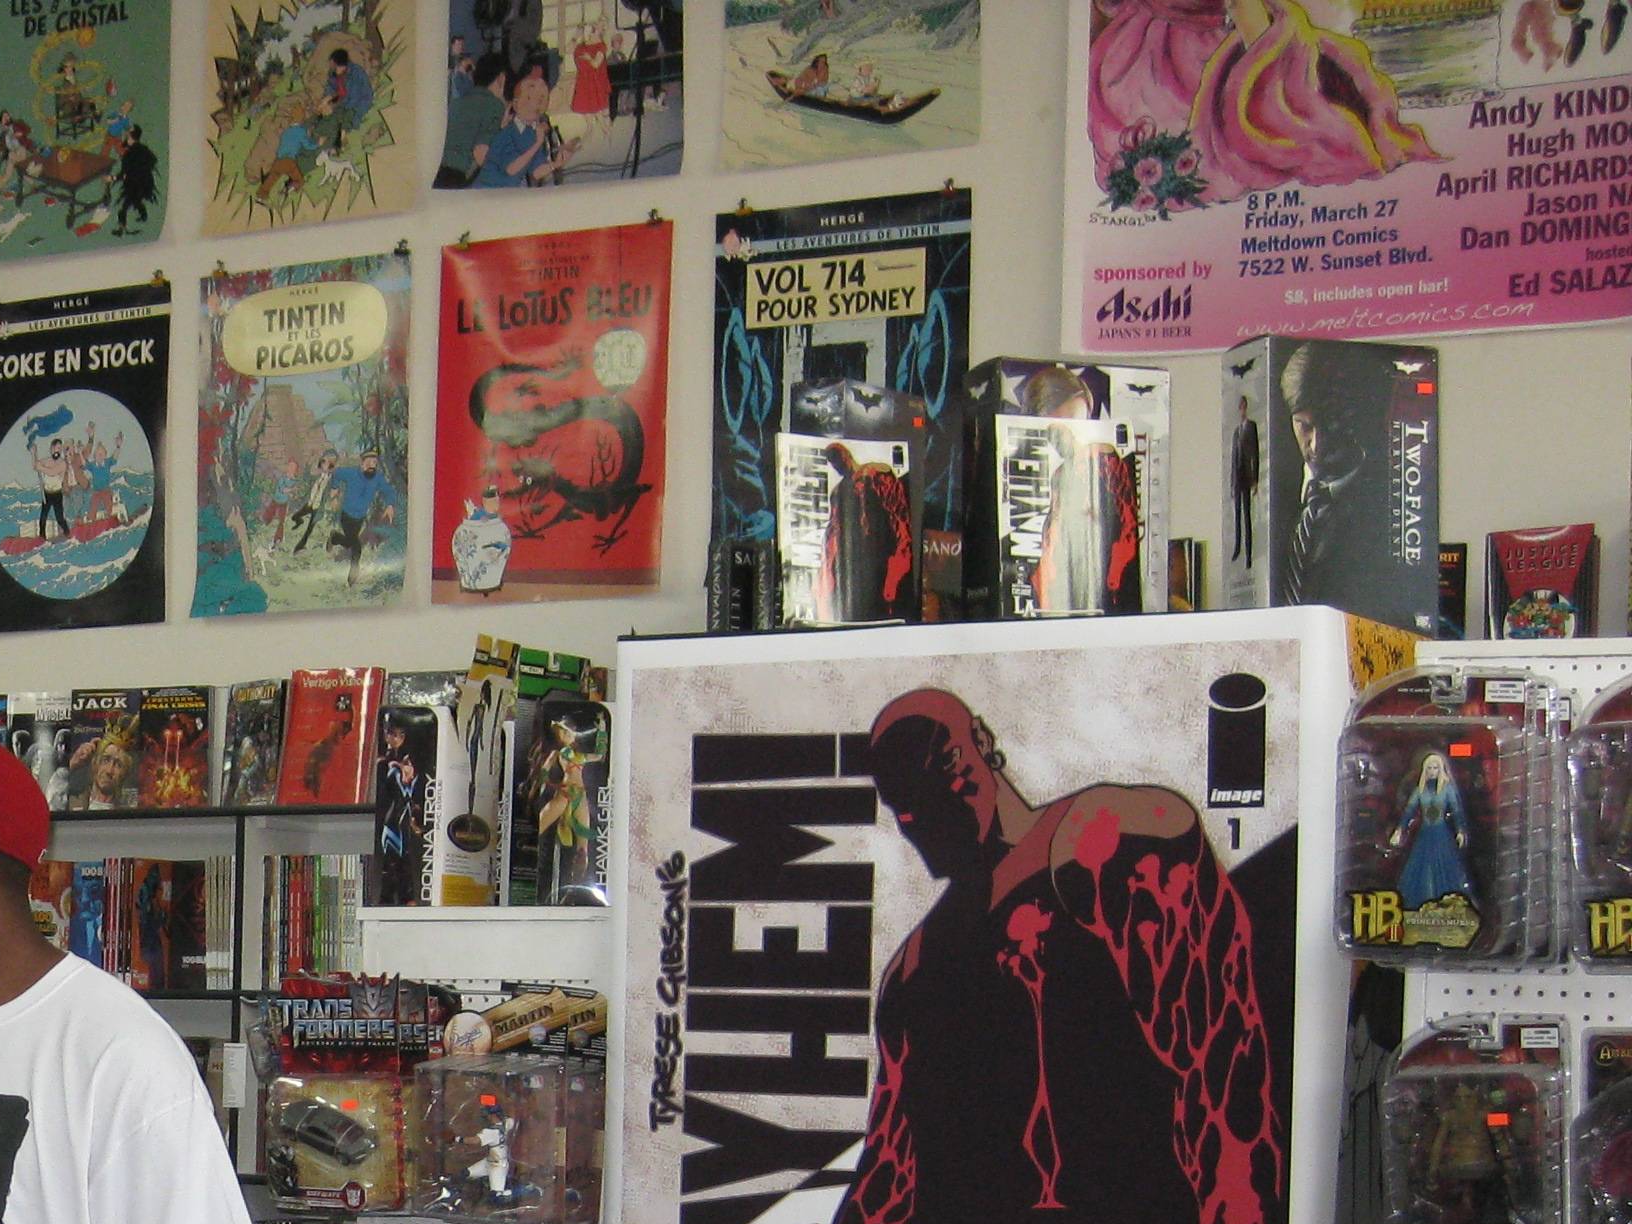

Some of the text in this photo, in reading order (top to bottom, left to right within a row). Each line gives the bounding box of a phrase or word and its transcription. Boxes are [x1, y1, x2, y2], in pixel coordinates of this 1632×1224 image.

[24, 15, 47, 37] DE
[56, 1, 128, 33] CRISTAL
[1469, 84, 1632, 129] Andy KIND
[1507, 122, 1632, 158] Hugh MO
[1435, 168, 1497, 200] April
[1244, 199, 1399, 229] Friday, March 27
[1247, 191, 1305, 211] 8 P.M.
[1524, 183, 1632, 217] Jason N
[820, 211, 865, 227] HERGÉ
[1460, 213, 1632, 250] Dan DOMING
[776, 224, 941, 250] LES AVENTURES DE TINTIN
[1240, 227, 1399, 255] Meltdown Comics
[755, 258, 866, 295] VOL 714
[1094, 261, 1212, 282] sponsored by
[1238, 248, 1434, 278] 7522 W. Sunset Blvd.
[1284, 278, 1449, 305] $8, includes open bar!
[1508, 273, 1540, 298] Ed
[53, 296, 90, 309] HERGÉ
[263, 301, 345, 333] TINTIN
[586, 282, 653, 322] BLEU
[756, 286, 916, 322] POUR SYDNEY
[1096, 283, 1193, 323] Asahi
[28, 307, 152, 331] LES AVENTURES DE TINTIN
[1145, 328, 1158, 338] #1
[1162, 327, 1193, 338] BEER
[288, 329, 321, 342] ET LES
[54, 348, 81, 374] EN
[88, 339, 155, 371] STOCK
[256, 336, 355, 370] PICAROS
[1390, 420, 1401, 558] HARVEY DENT
[1401, 419, 1429, 567] TWO-FACE
[1505, 542, 1581, 562] JUSTICE
[1505, 556, 1578, 573] LEAGUE
[711, 552, 722, 632] SANDMAN
[1013, 595, 1036, 618] LA
[303, 676, 339, 688] Vertigo
[73, 696, 128, 710] JACK
[1210, 788, 1263, 803] image
[421, 773, 438, 902] DONNA TROY
[595, 777, 610, 887] HAWK GIRL
[1227, 818, 1240, 849] 1
[656, 848, 689, 1008] GIBSON'S
[1351, 893, 1402, 941] HB
[276, 999, 353, 1028] TRANS
[493, 1002, 555, 1037] MARTIN
[293, 1019, 398, 1048] FORMERS
